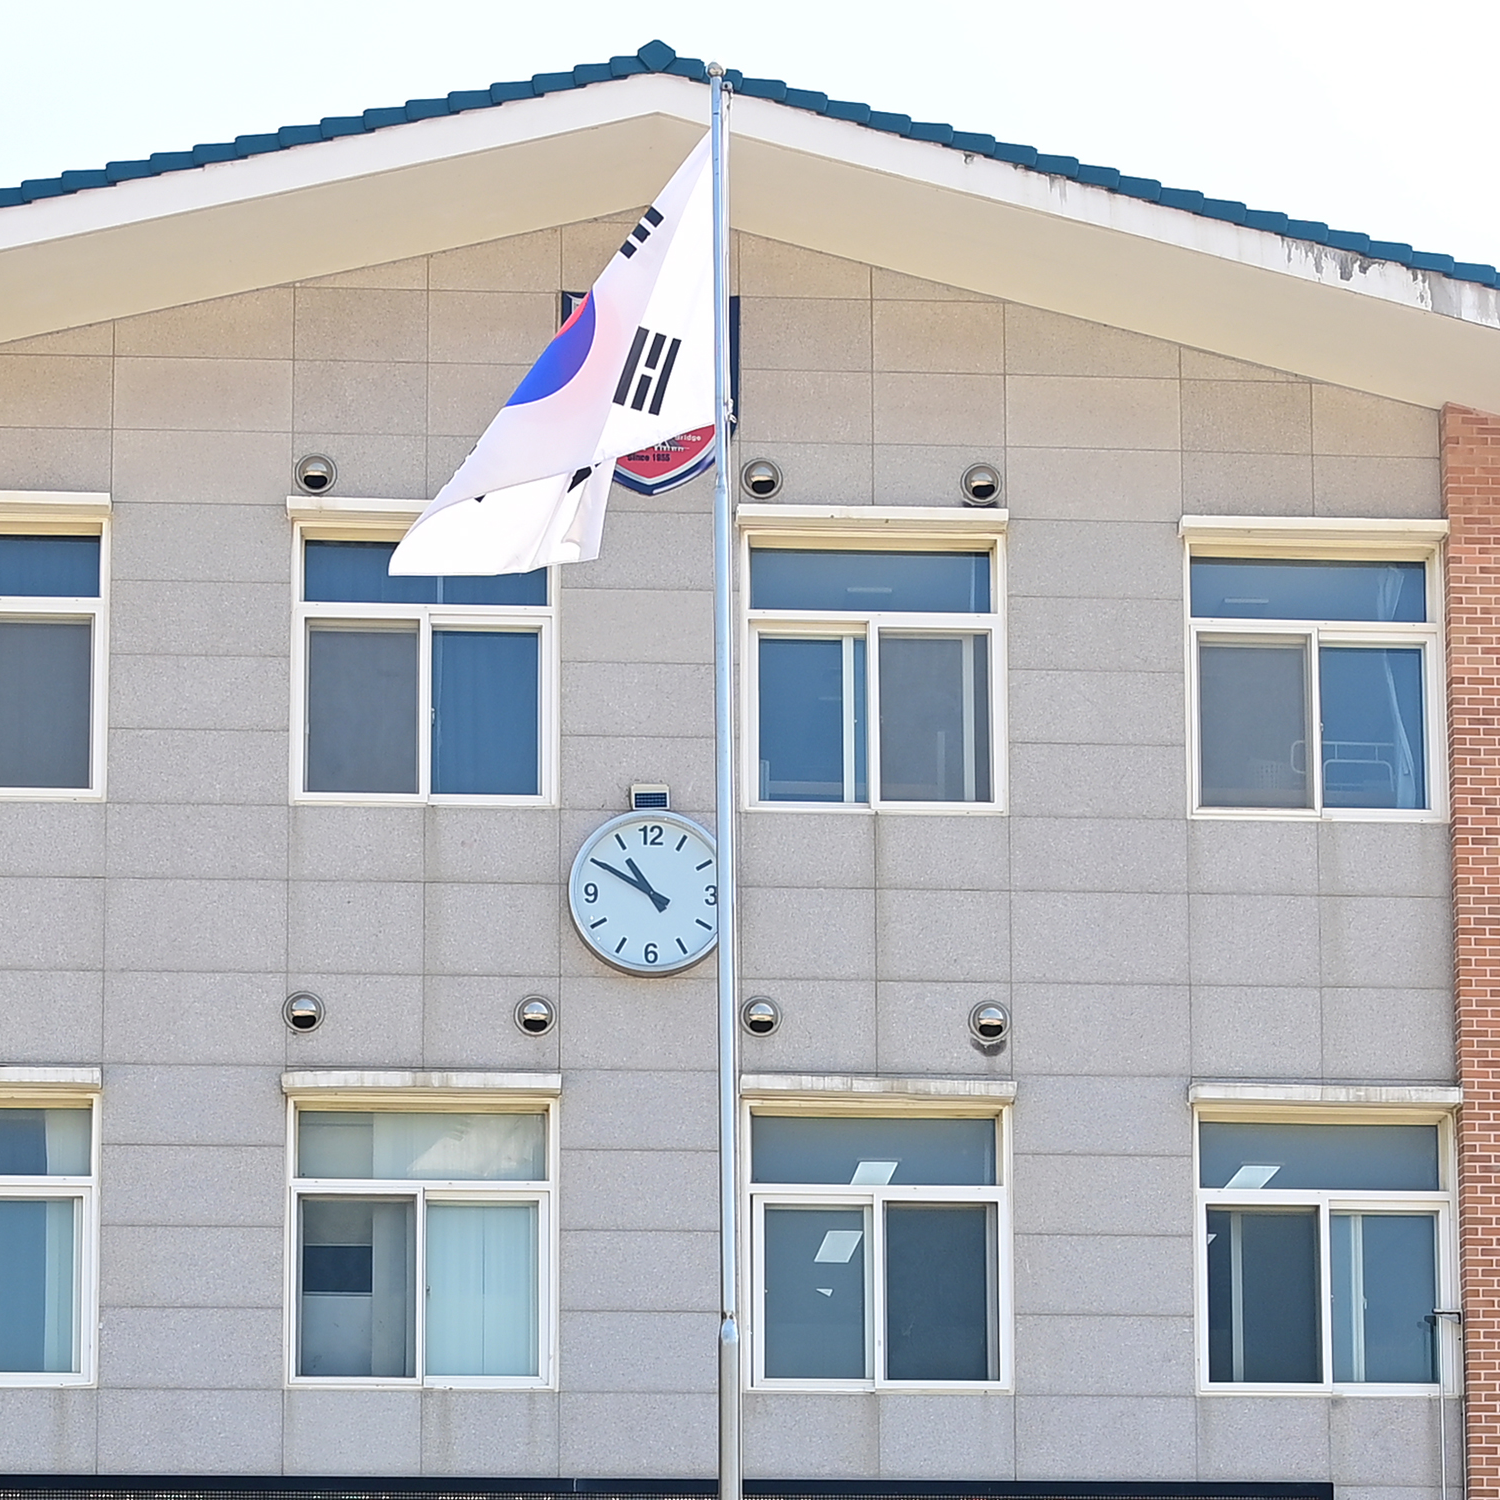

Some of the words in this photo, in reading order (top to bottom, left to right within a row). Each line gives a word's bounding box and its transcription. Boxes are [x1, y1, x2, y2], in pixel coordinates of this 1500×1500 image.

[638, 825, 664, 846] 12
[584, 883, 598, 904] 9
[704, 885, 717, 906] 3
[644, 943, 659, 963] 6
